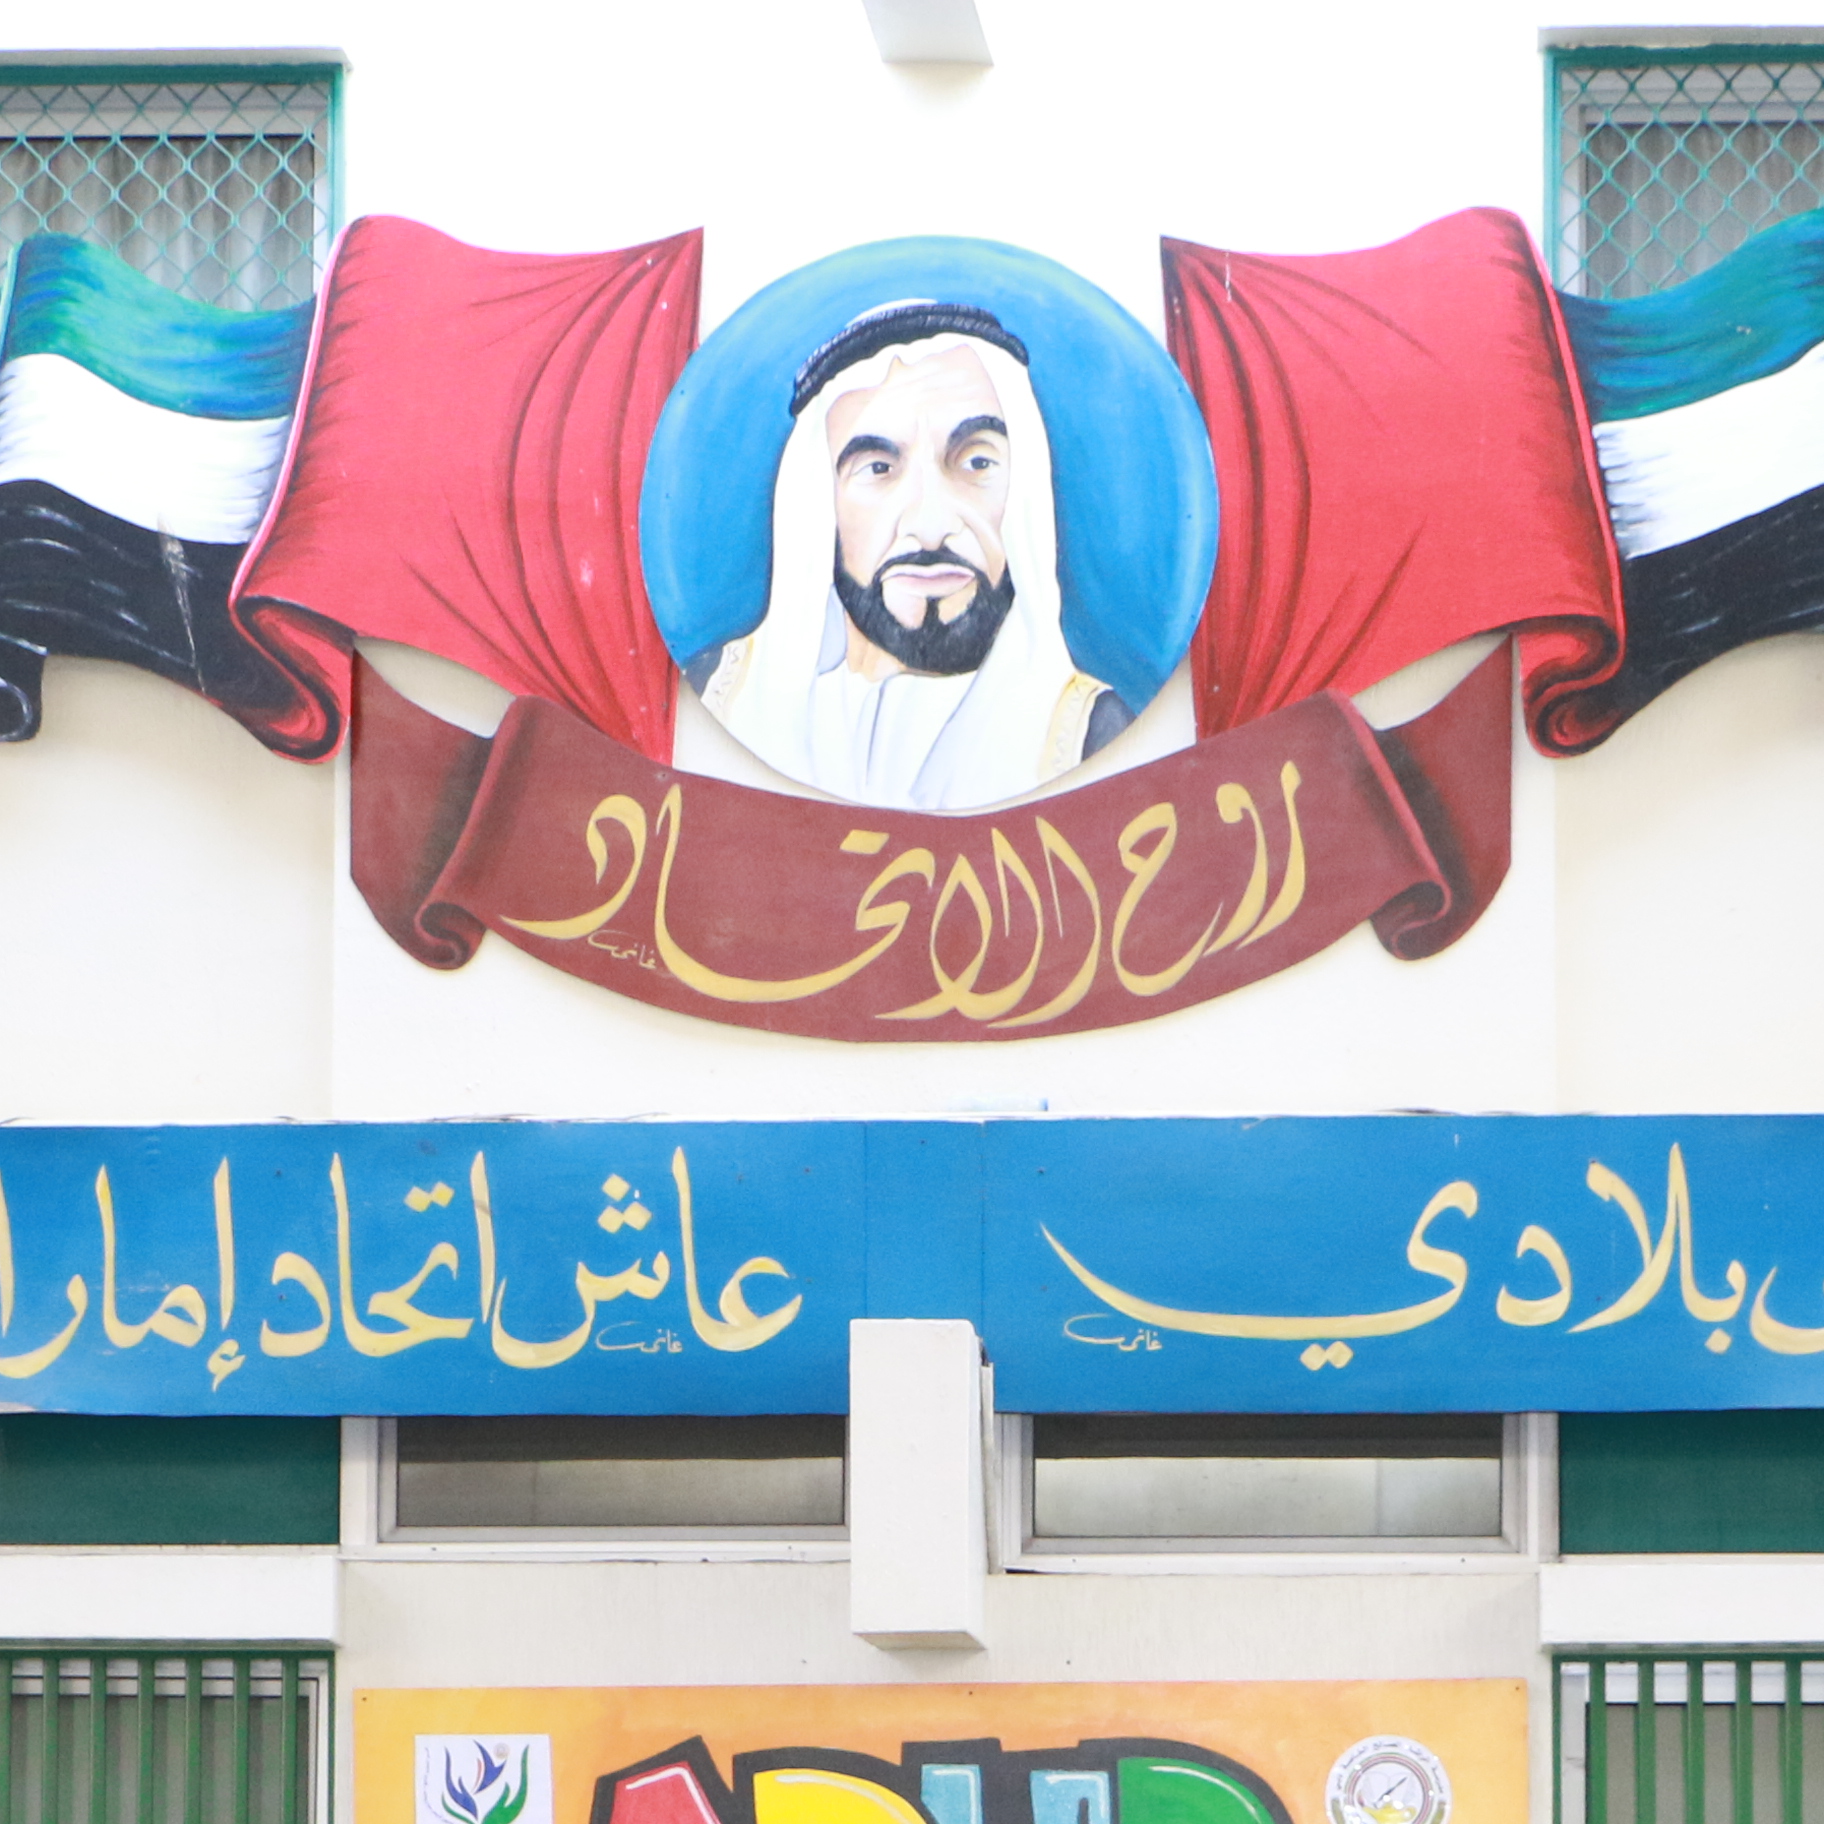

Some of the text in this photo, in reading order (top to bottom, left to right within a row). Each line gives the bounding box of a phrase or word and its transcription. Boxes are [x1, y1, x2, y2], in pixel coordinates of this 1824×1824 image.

[1111, 760, 1306, 997] روح
[260, 1149, 497, 1360] اتحاد
[490, 1145, 805, 1369] عاش
[1039, 1143, 1744, 1370] بلادي
